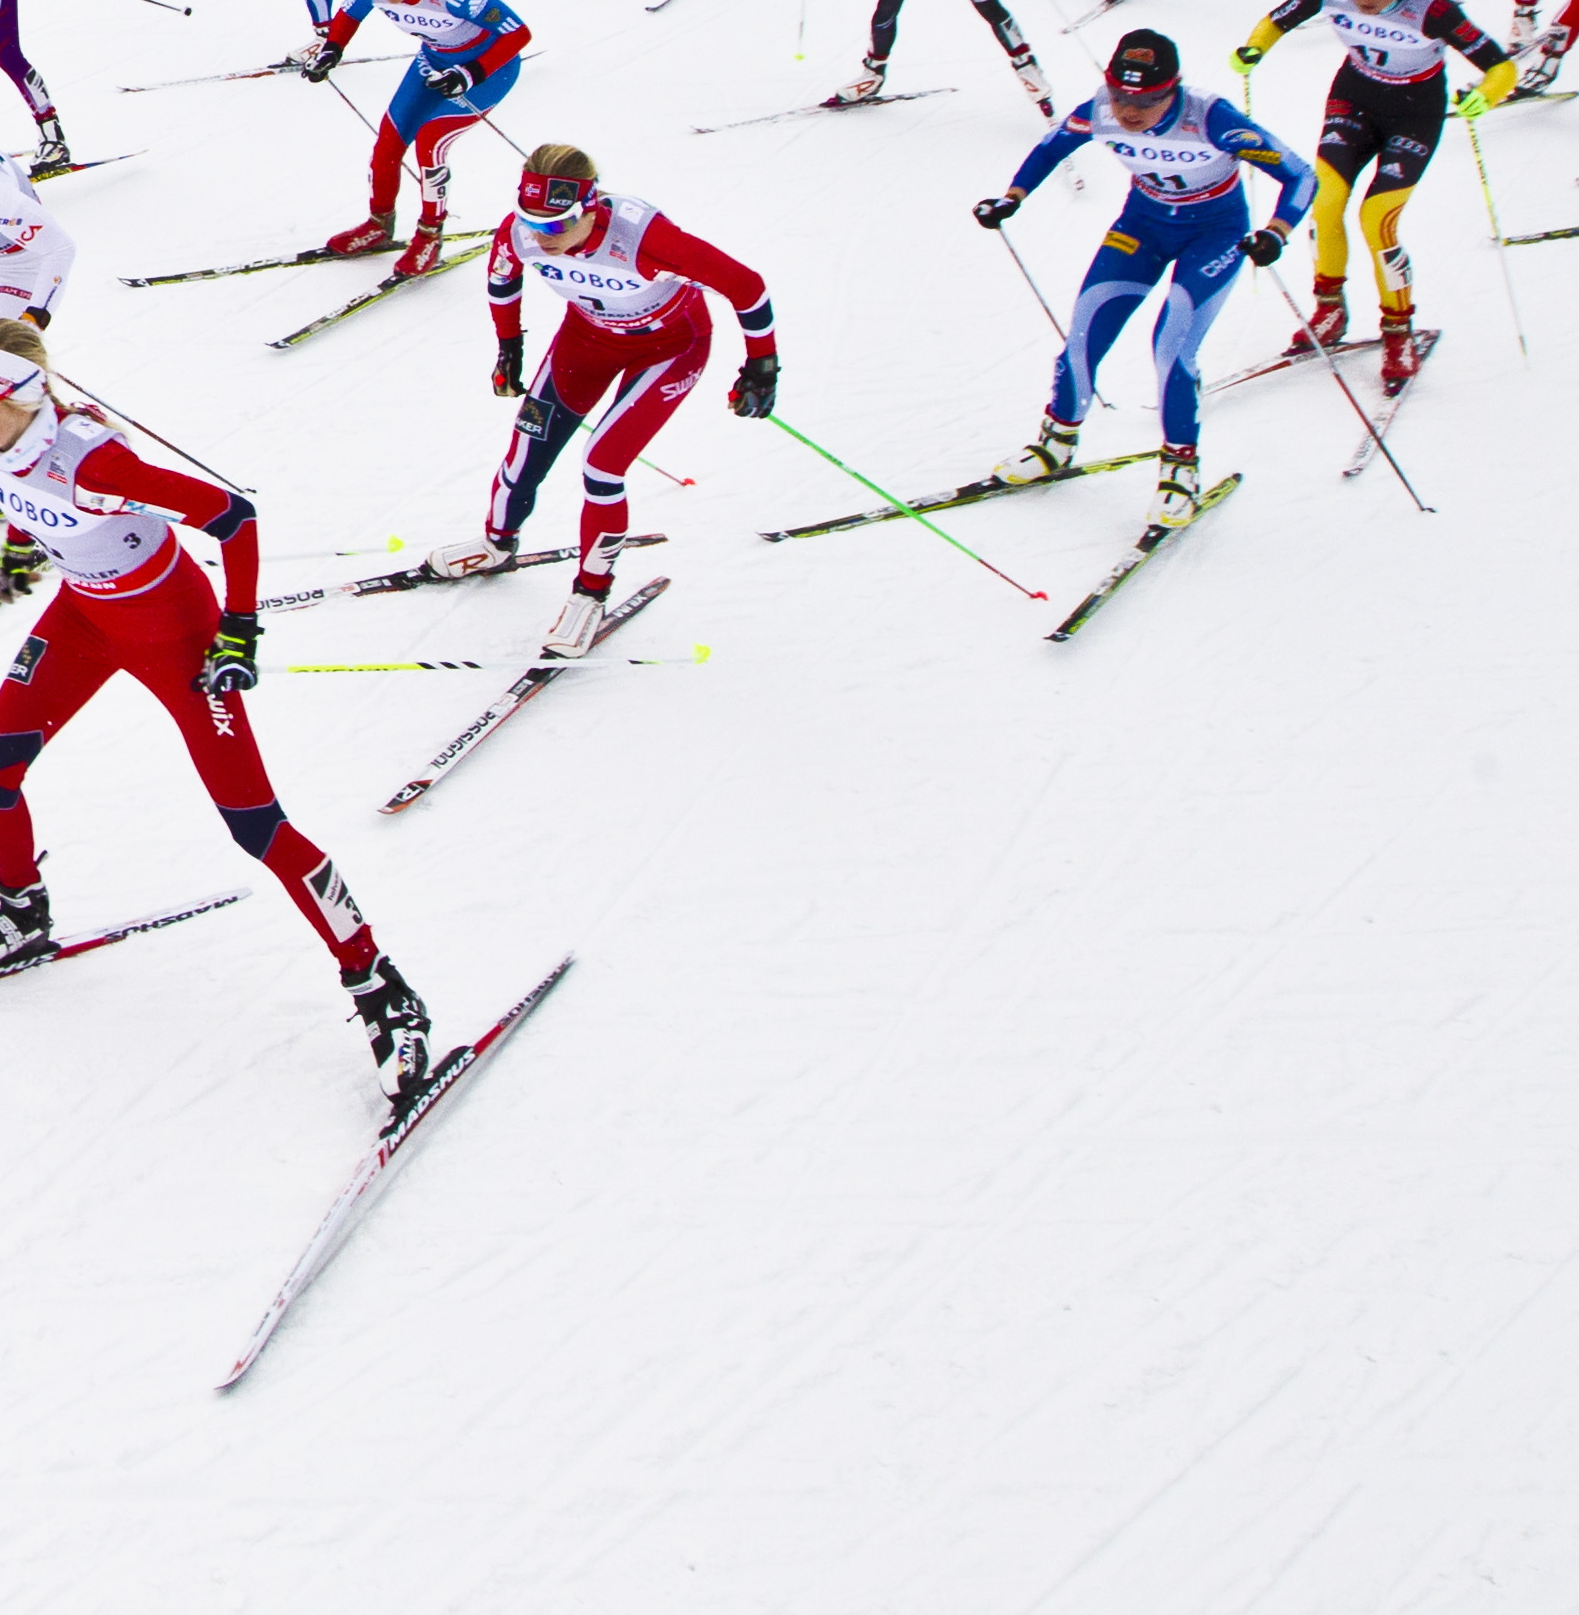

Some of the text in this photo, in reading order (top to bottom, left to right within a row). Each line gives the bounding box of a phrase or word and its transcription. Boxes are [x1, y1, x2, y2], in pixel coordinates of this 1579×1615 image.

[404, 12, 454, 29] OBOS
[1358, 23, 1421, 45] OBOS
[1143, 147, 1212, 163] OBOS
[436, 185, 447, 199] 9
[569, 270, 641, 291] OBOS
[9, 492, 78, 528] OBOS
[123, 532, 142, 550] 3
[206, 690, 237, 738] wix
[104, 895, 239, 943] MADSHUS
[344, 895, 364, 925] 3
[389, 1047, 477, 1151] MADSHUS
